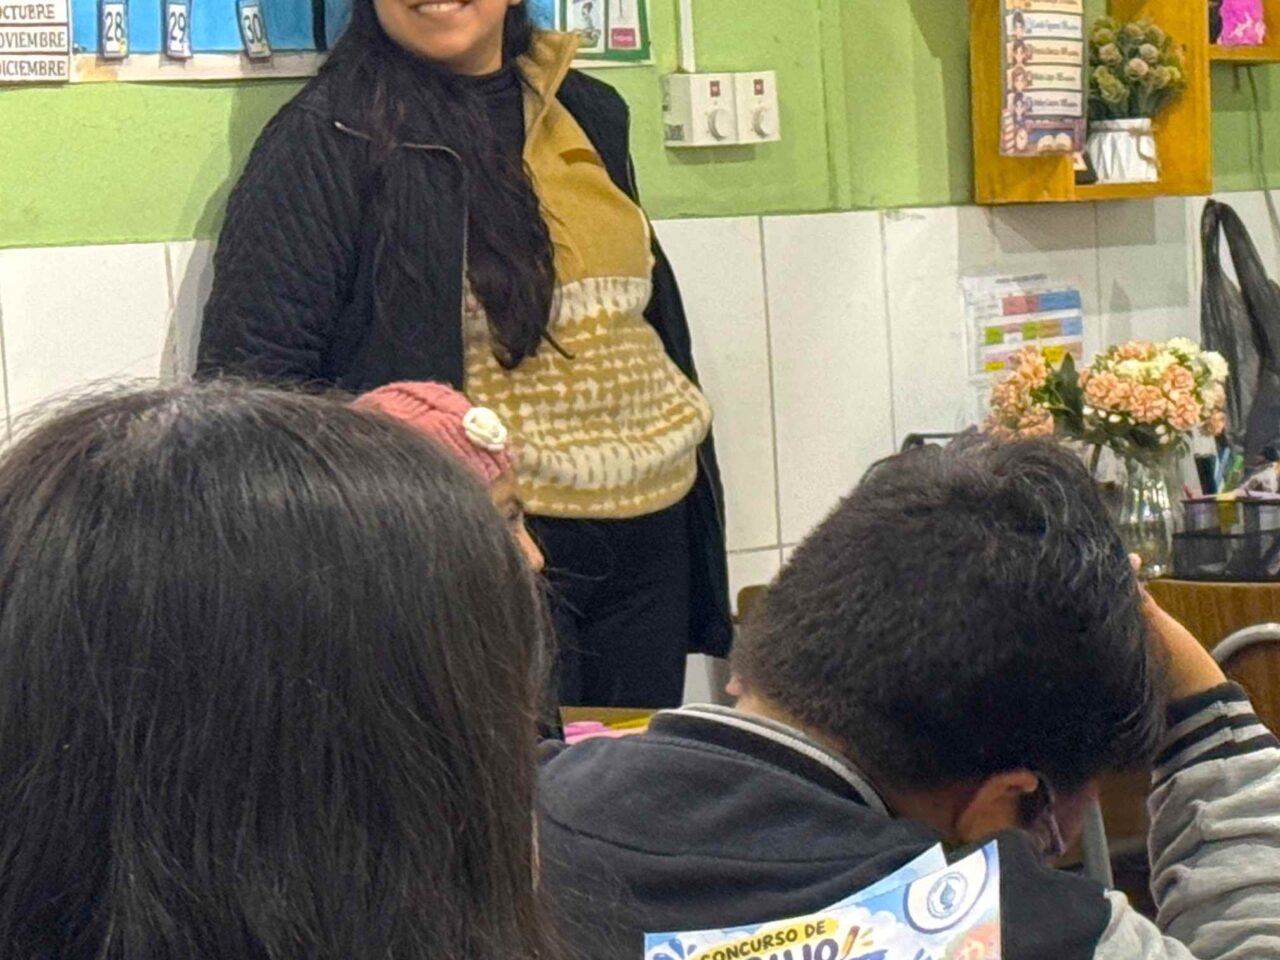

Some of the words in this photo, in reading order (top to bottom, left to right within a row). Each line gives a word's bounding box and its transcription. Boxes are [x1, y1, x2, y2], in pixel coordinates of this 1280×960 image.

[0, 4, 56, 20] CTUBRE
[104, 11, 124, 43] 28
[168, 11, 188, 43] 29
[243, 11, 263, 44] 30
[0, 31, 66, 48] OVIEMBRE
[0, 60, 66, 77] ICIEMBRE
[804, 920, 827, 939] DE
